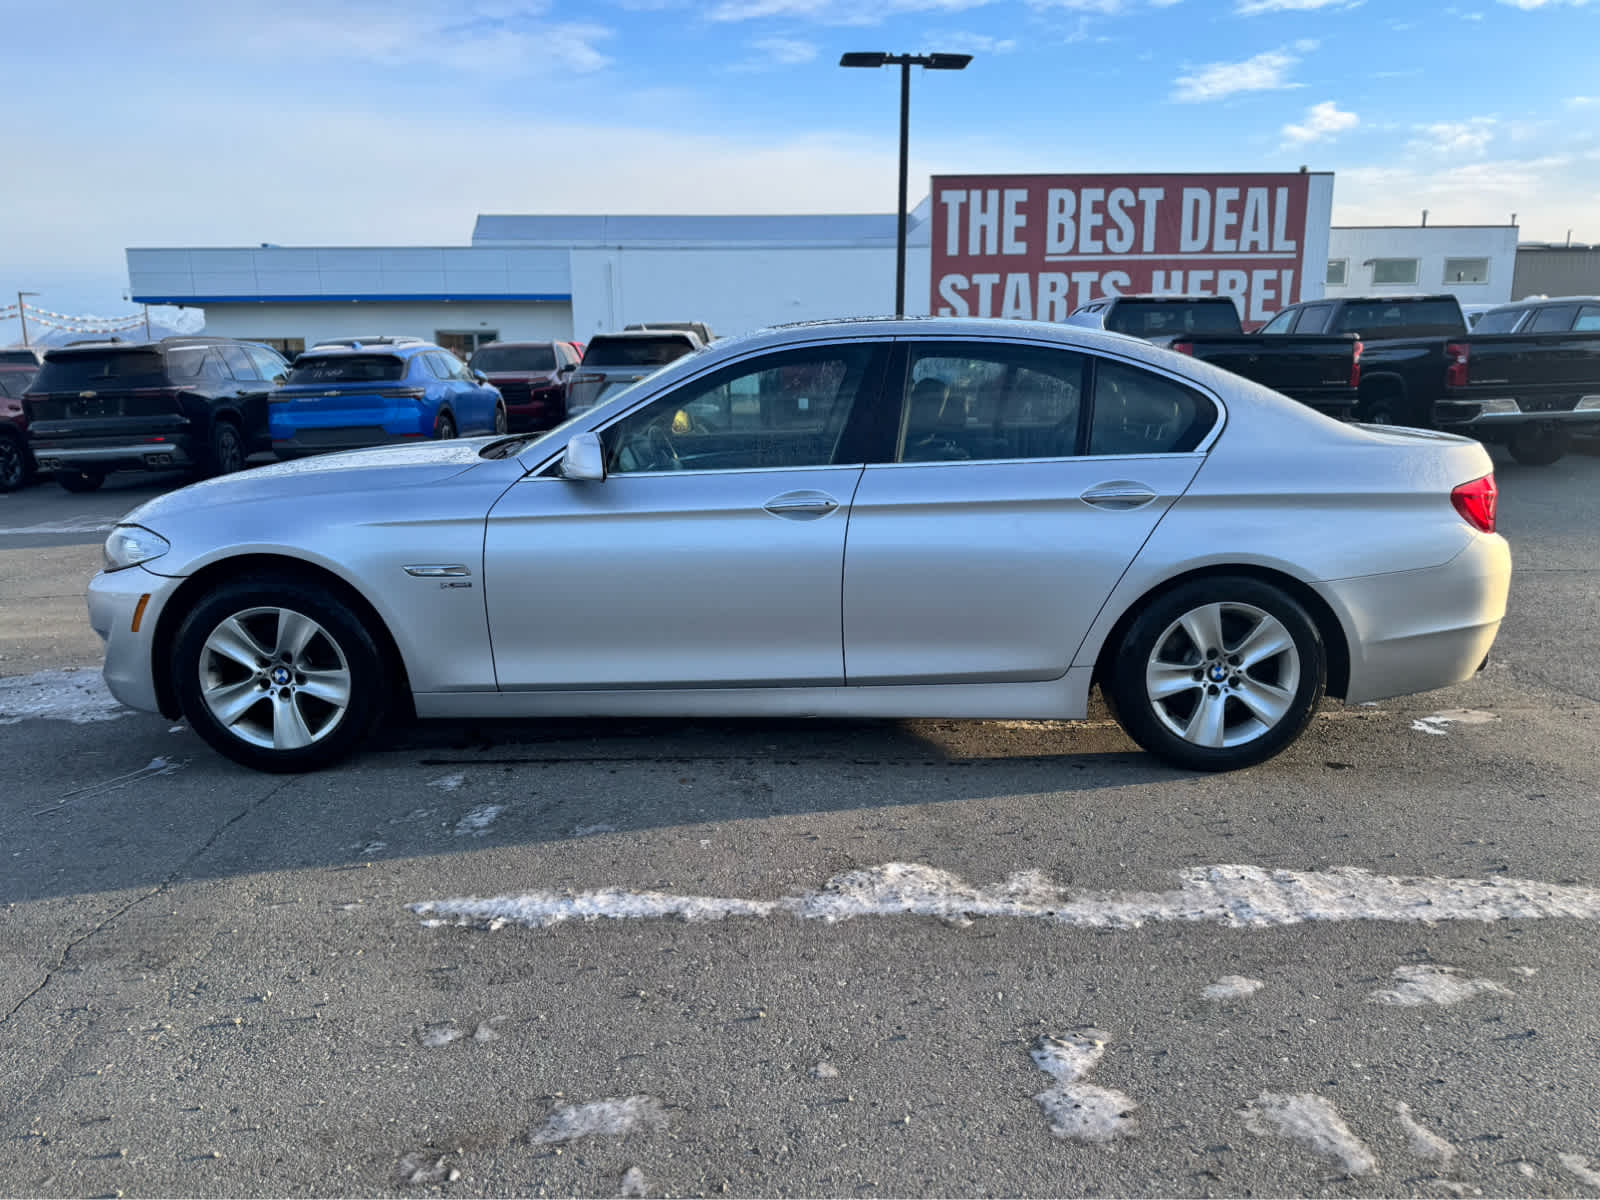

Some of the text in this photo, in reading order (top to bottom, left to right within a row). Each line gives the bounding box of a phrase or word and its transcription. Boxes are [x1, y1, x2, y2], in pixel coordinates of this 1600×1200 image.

[941, 187, 1297, 256] THE BEST DEAL
